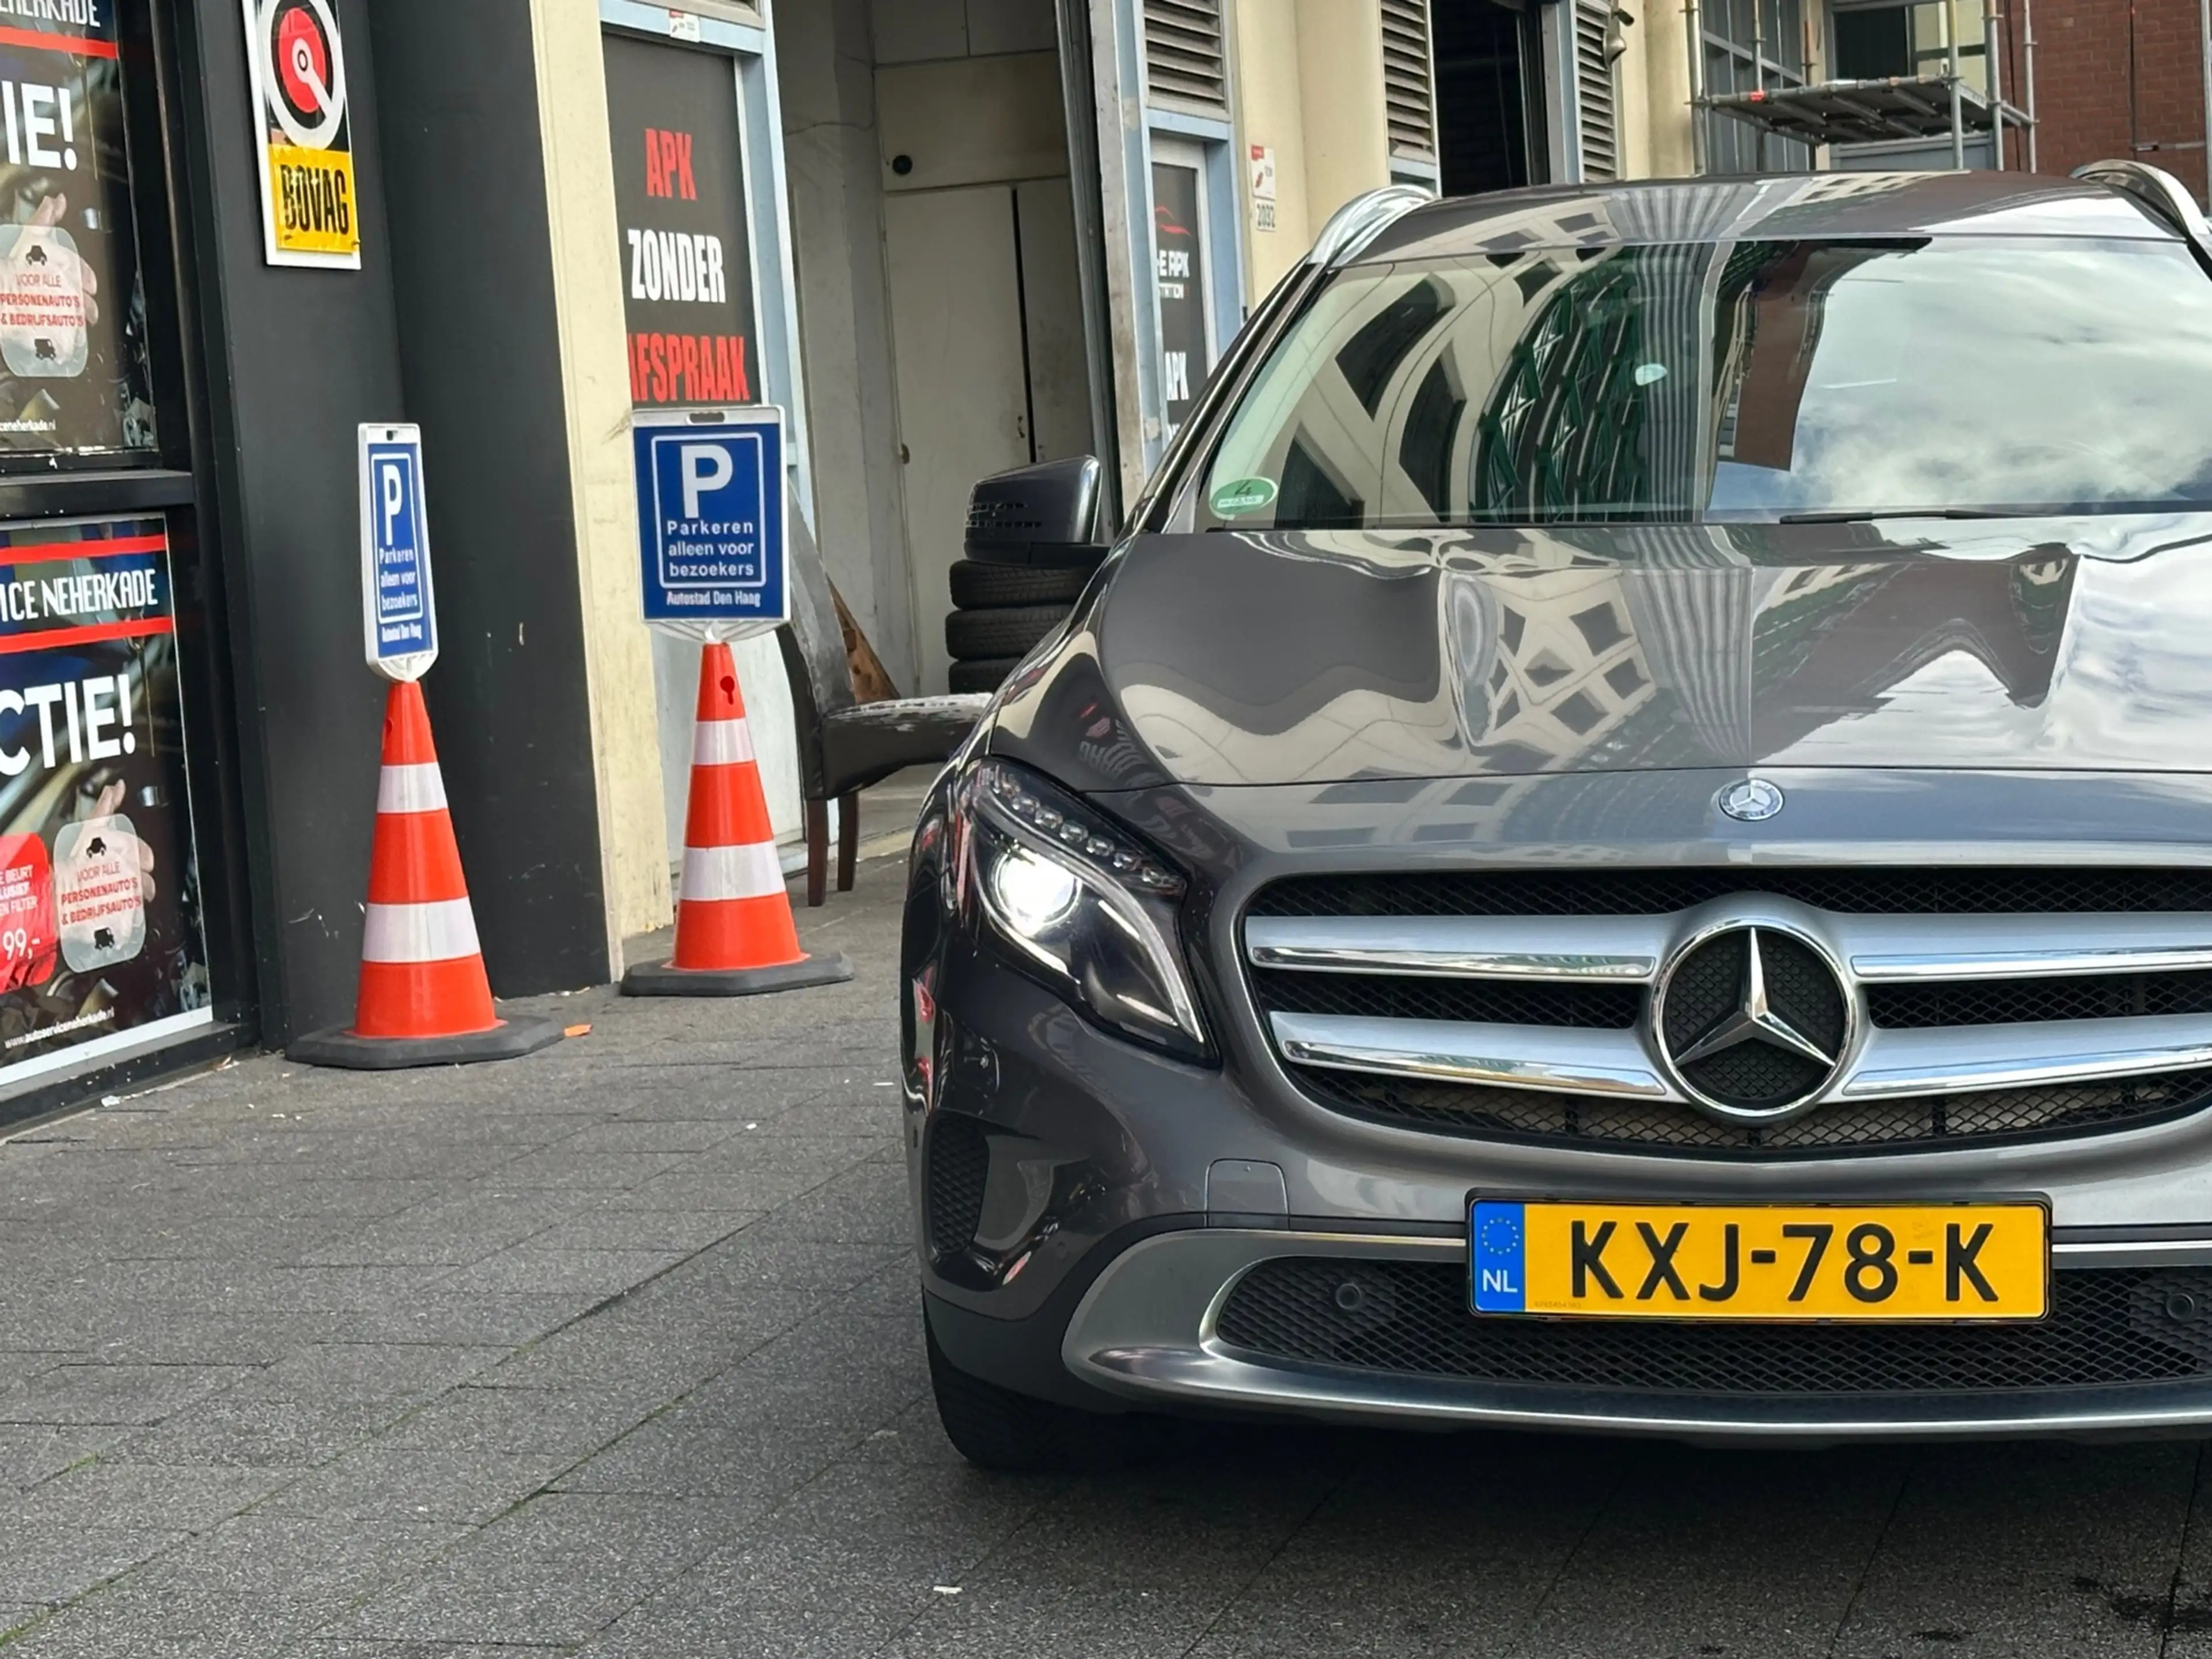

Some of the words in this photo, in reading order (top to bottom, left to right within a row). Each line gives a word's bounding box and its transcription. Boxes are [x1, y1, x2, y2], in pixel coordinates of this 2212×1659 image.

[2, 81, 77, 171] IE!
[645, 128, 697, 200] APK
[280, 164, 349, 235] BOVAG
[16, 273, 40, 286] VOOR
[42, 274, 62, 287] ALLE
[628, 229, 726, 303] ZONDER
[1168, 250, 1190, 278] APK
[1165, 351, 1190, 401] APK
[681, 445, 733, 518] P
[382, 465, 402, 546] P
[667, 520, 753, 535] Parkeren
[379, 547, 414, 564] Parkeren
[668, 541, 714, 556] alleen
[718, 543, 754, 555] voor
[669, 562, 754, 577] bezoekers
[41, 569, 158, 616] NEHERKADE
[381, 591, 418, 611] bezoekers
[666, 591, 710, 606] Autostad
[714, 592, 732, 604] Den
[735, 592, 761, 607] Haag
[0, 674, 135, 776] CTIE!
[77, 866, 100, 882] VOOR
[102, 862, 120, 876] ALLE
[1570, 1220, 1999, 1304] KXJ-78-K
[1483, 1269, 1518, 1294] NL
